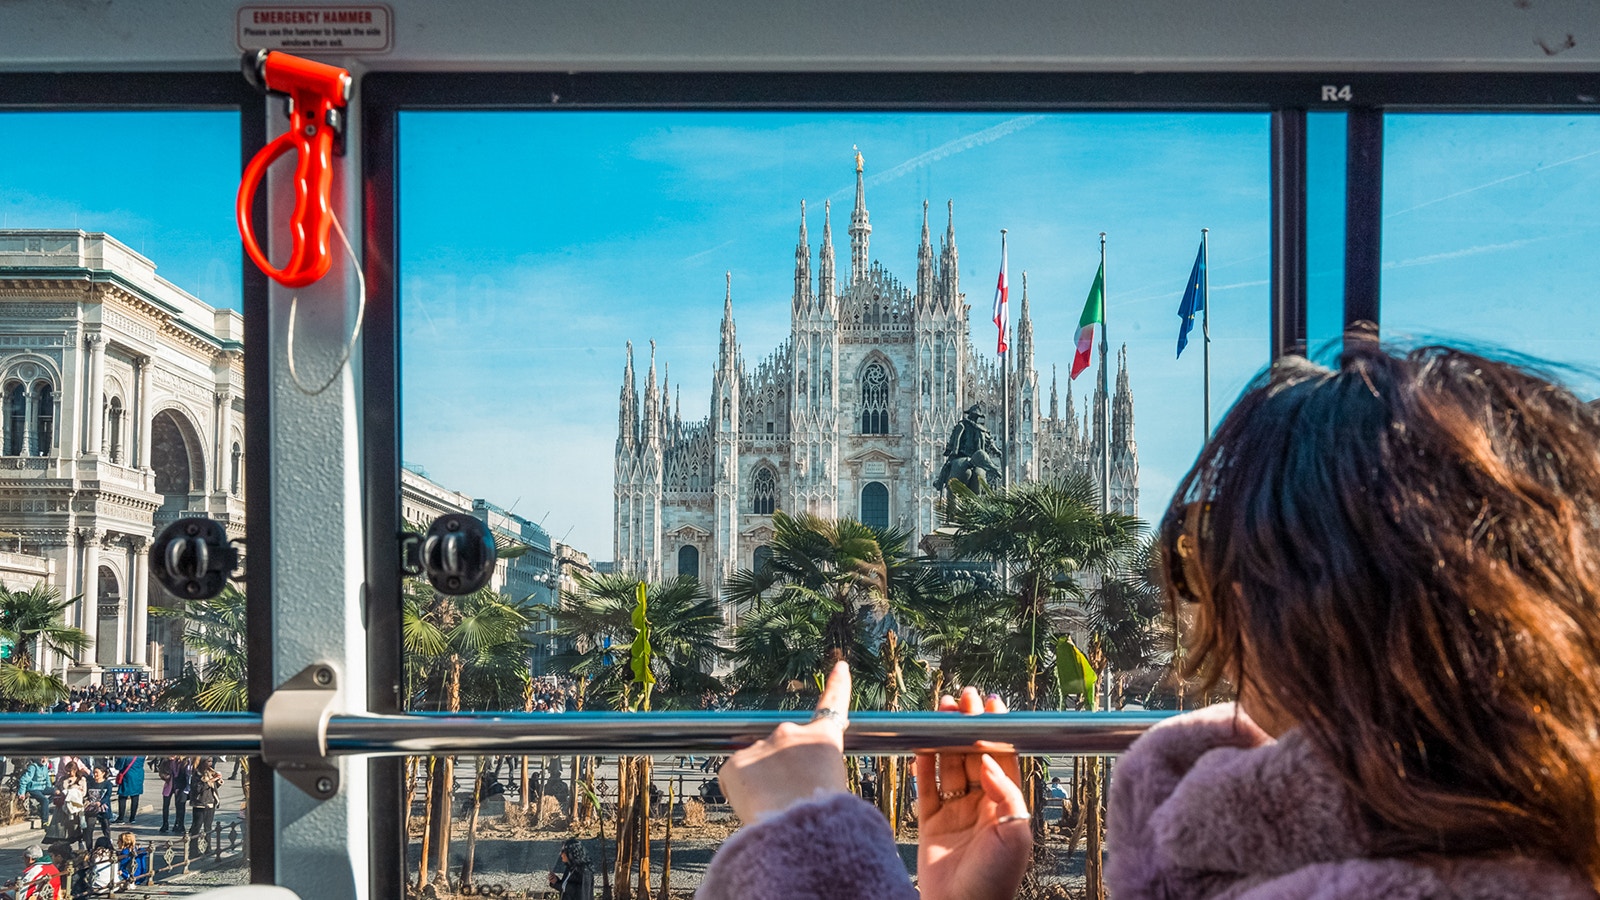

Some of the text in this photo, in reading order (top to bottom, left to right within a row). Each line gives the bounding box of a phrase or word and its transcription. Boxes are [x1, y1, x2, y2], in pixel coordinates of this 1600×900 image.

[253, 11, 372, 24] EMERGENCY HAMMER
[244, 28, 266, 36] Please
[282, 28, 293, 36] the
[295, 28, 323, 36] hammer
[324, 28, 332, 36] to
[333, 28, 352, 36] break
[353, 28, 364, 36] the
[366, 28, 381, 36] side
[1321, 84, 1353, 101] R4
